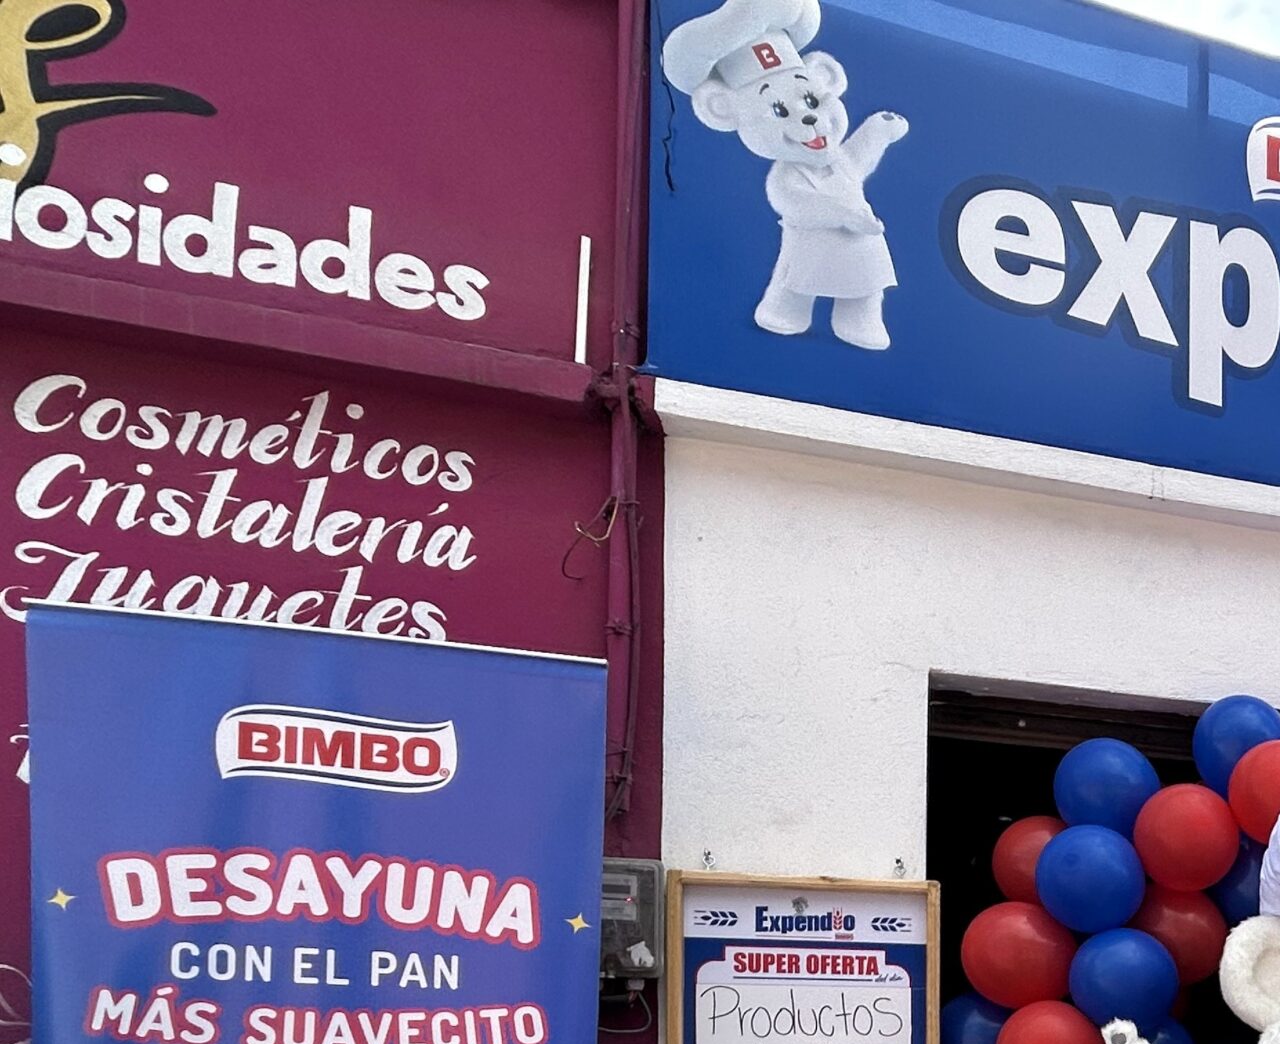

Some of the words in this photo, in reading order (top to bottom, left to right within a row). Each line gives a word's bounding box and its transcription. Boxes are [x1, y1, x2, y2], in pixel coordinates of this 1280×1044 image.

[752, 43, 781, 70] B
[13, 374, 477, 493] Cosméticos
[15, 453, 477, 571] Cristalería
[238, 721, 442, 776] BIMBO
[106, 853, 536, 945] DESAYUNA
[170, 942, 272, 983] CON
[293, 947, 349, 987] EL
[371, 951, 459, 990] PAN
[733, 952, 800, 974] SUPER
[806, 954, 879, 976] OFERTA
[91, 986, 216, 1044] MÁS
[700, 985, 904, 1039] Productos
